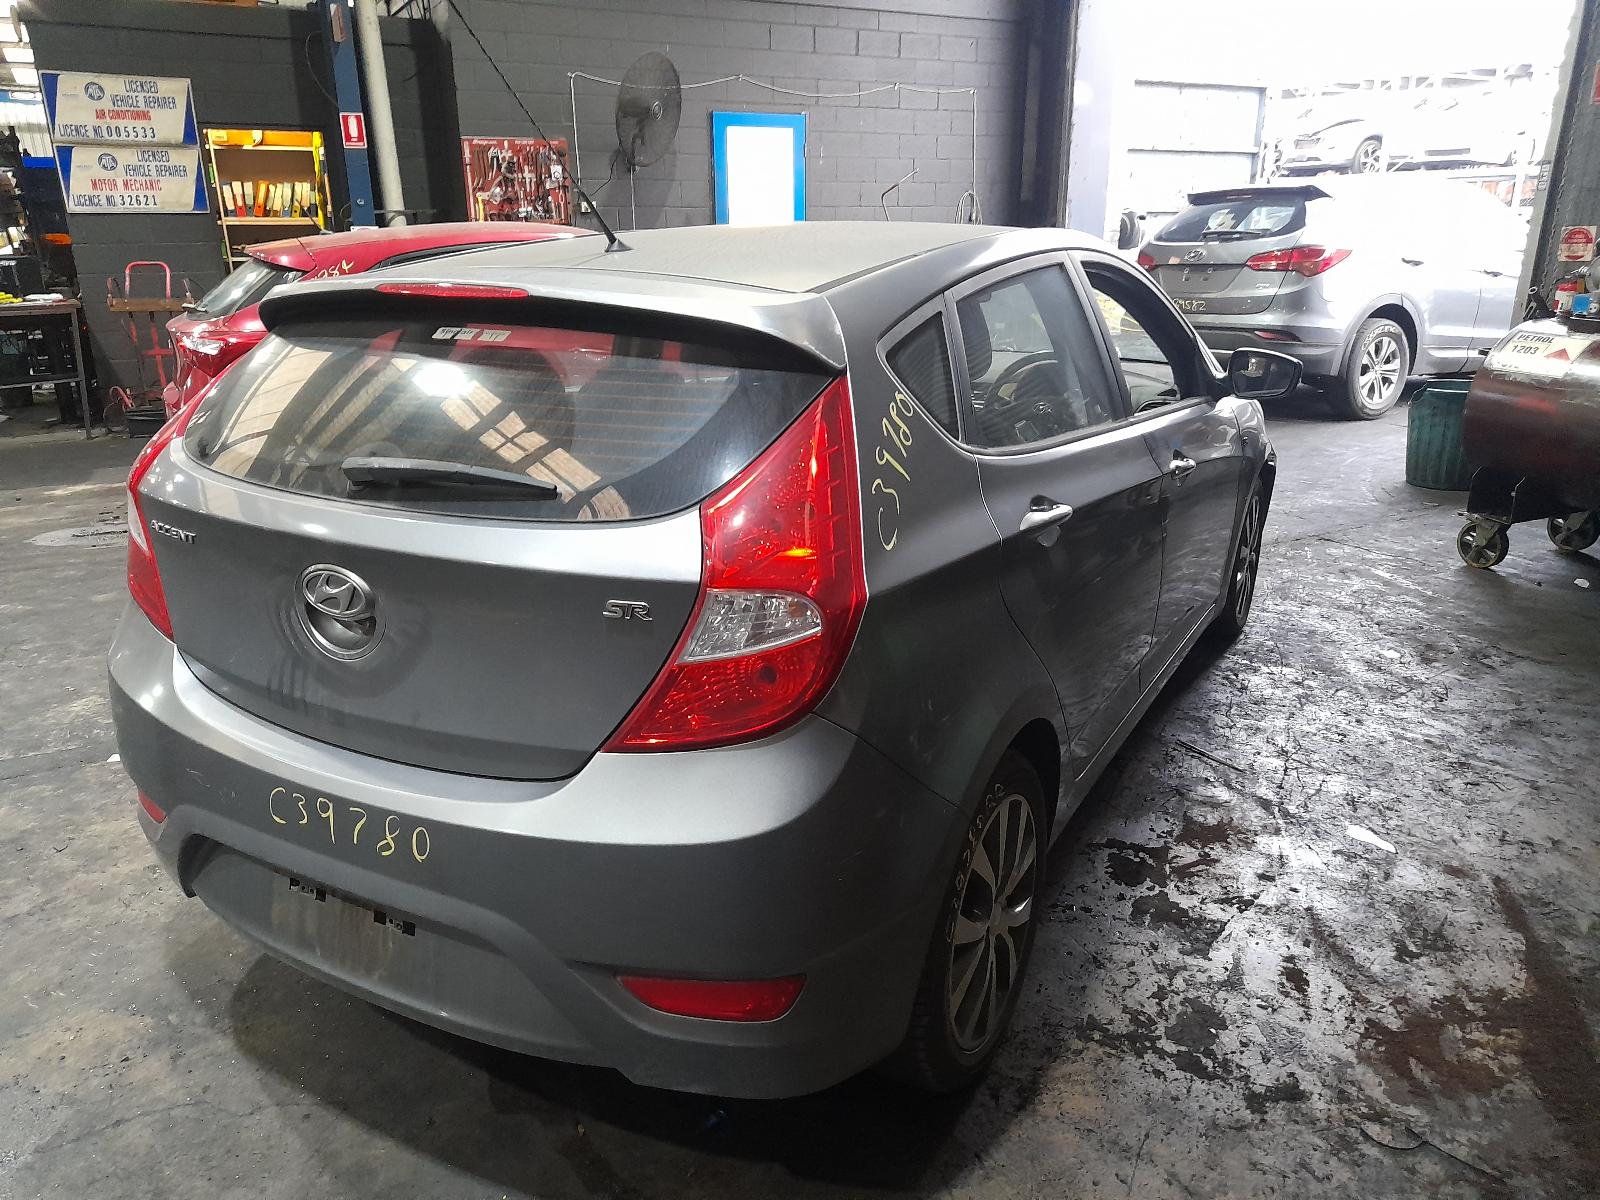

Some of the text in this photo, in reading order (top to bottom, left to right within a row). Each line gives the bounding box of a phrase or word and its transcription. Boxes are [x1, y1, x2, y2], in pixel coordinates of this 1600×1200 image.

[124, 80, 158, 94] LICENSED
[110, 94, 177, 110] VEHICLE REPAIRER
[95, 109, 152, 121] AIR CONDITIONING
[58, 124, 90, 138] LICENCE
[106, 126, 156, 139] 005533
[136, 150, 170, 163] LICENSED
[123, 164, 188, 178] VEHICLE REPAIRER
[90, 178, 162, 192] MOTOR MECHANIC
[72, 194, 103, 207] LICENCE
[120, 194, 158, 207] 32621
[1517, 334, 1555, 344] PETROL
[1512, 344, 1540, 355] 1203
[871, 390, 914, 551] C39780
[151, 520, 197, 545] ACCENT
[269, 787, 430, 863] C39780
